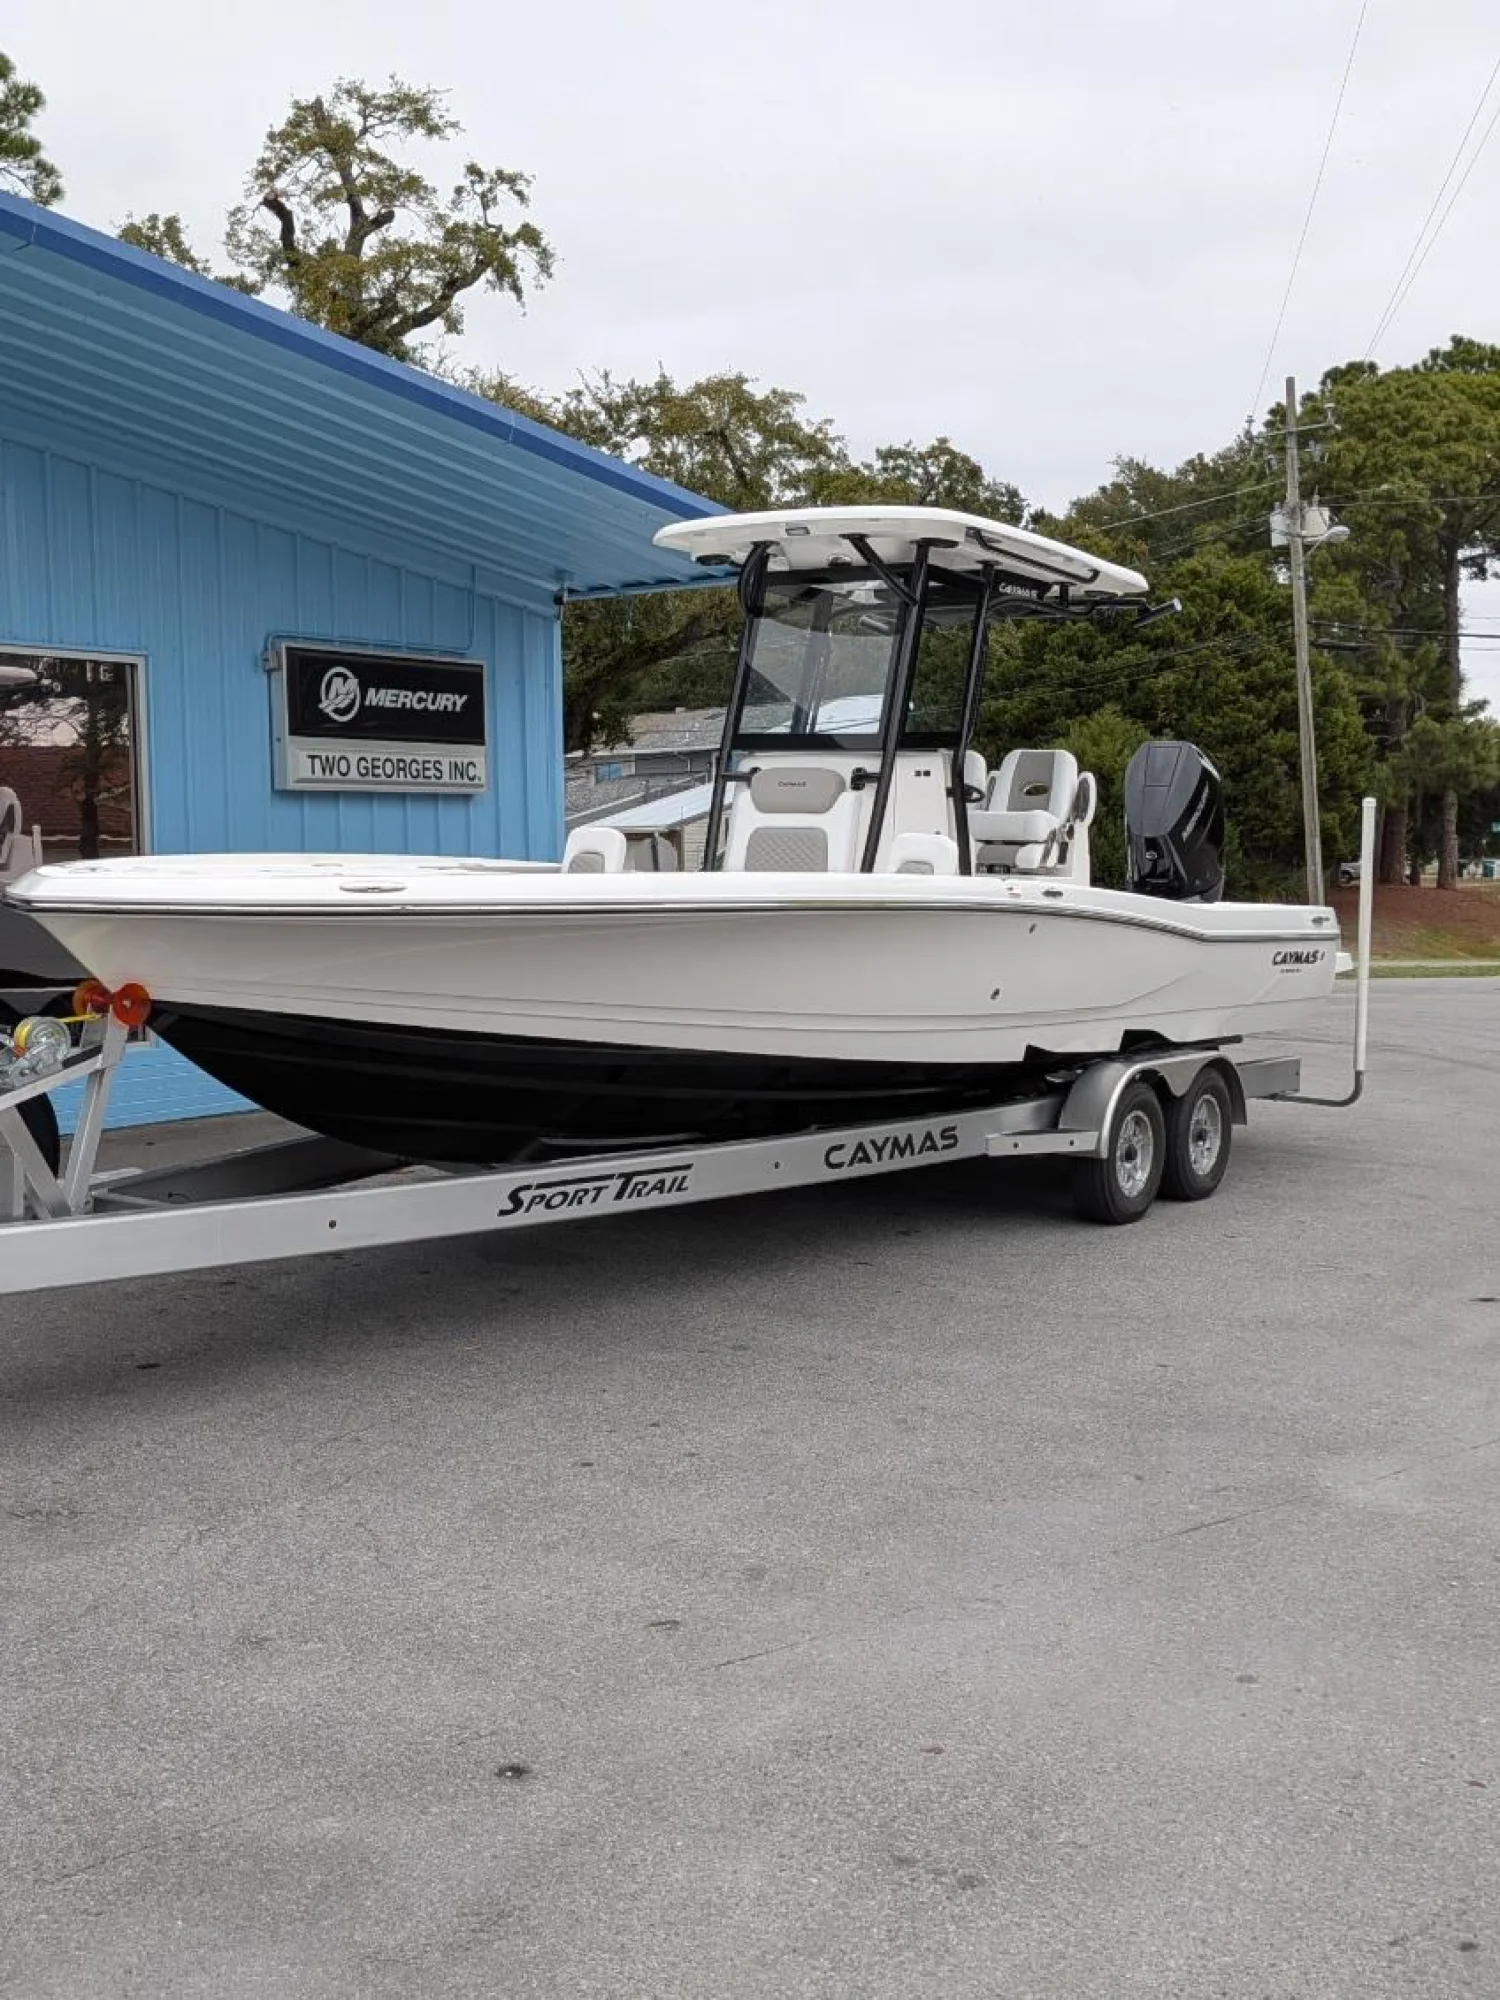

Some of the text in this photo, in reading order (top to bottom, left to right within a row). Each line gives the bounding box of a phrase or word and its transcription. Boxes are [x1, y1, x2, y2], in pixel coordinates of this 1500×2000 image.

[365, 687, 468, 713] MERCURY
[307, 754, 482, 782] TWO GEORGES INC.
[824, 1125, 959, 1169] CAYMAS
